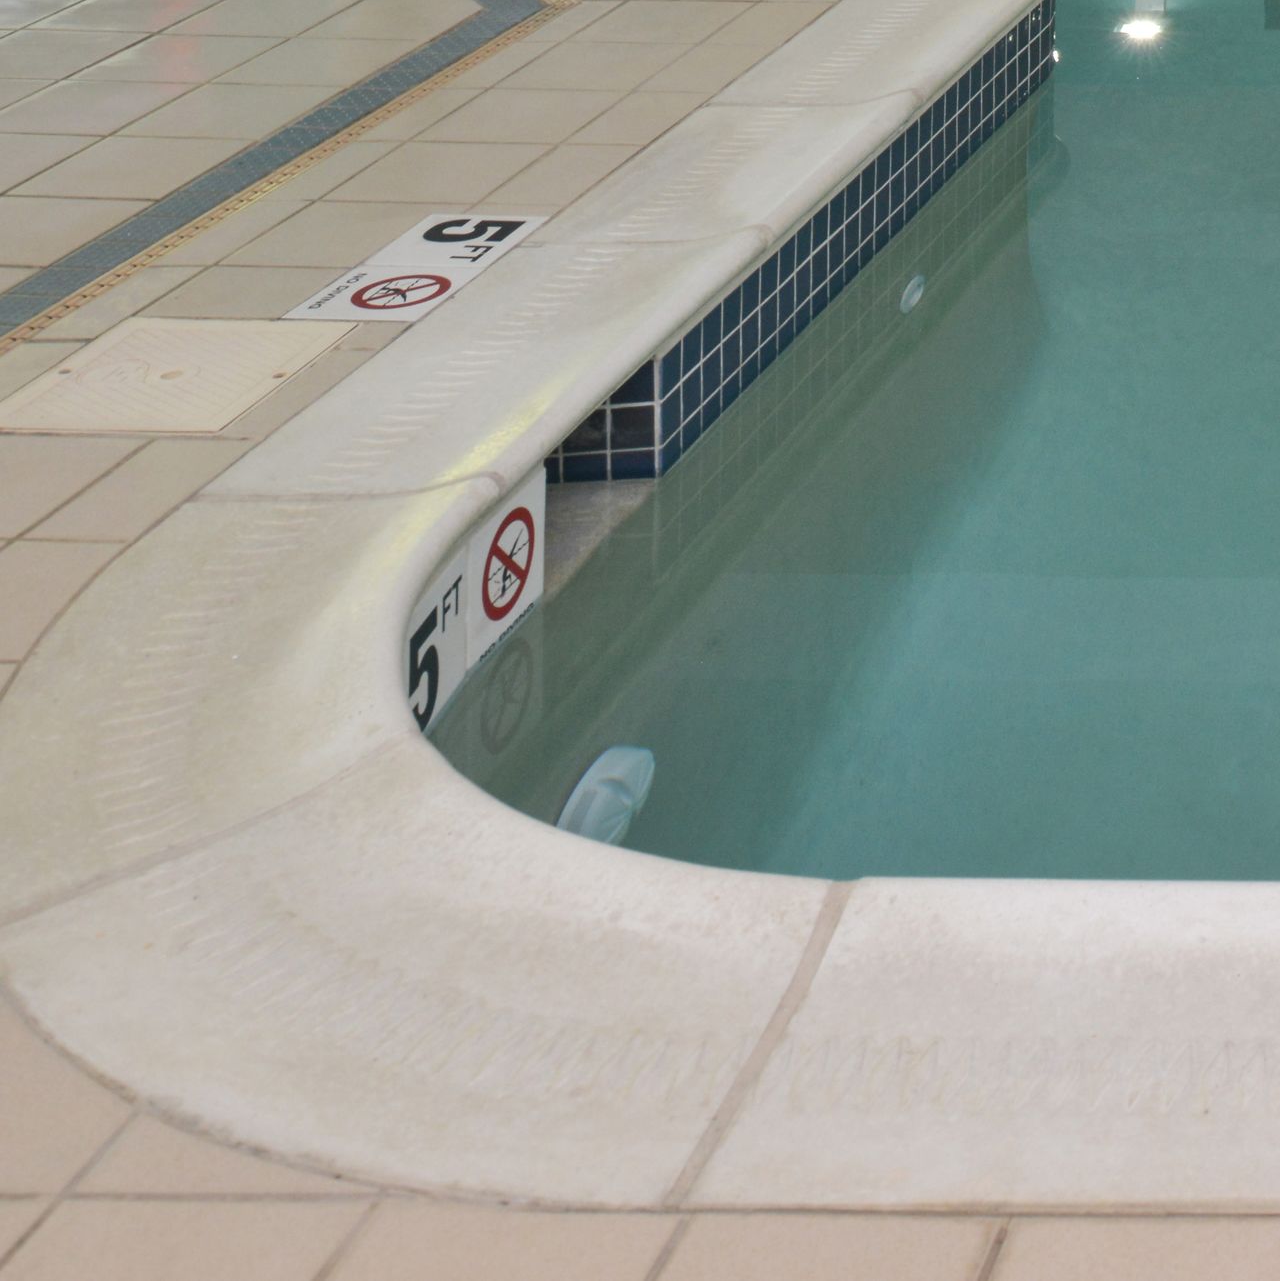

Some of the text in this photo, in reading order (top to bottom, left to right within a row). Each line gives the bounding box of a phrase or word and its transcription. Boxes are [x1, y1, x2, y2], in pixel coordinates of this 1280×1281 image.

[422, 218, 527, 263] 5 FT
[307, 272, 369, 311] NO DIVING
[408, 573, 463, 733] 5 FT
